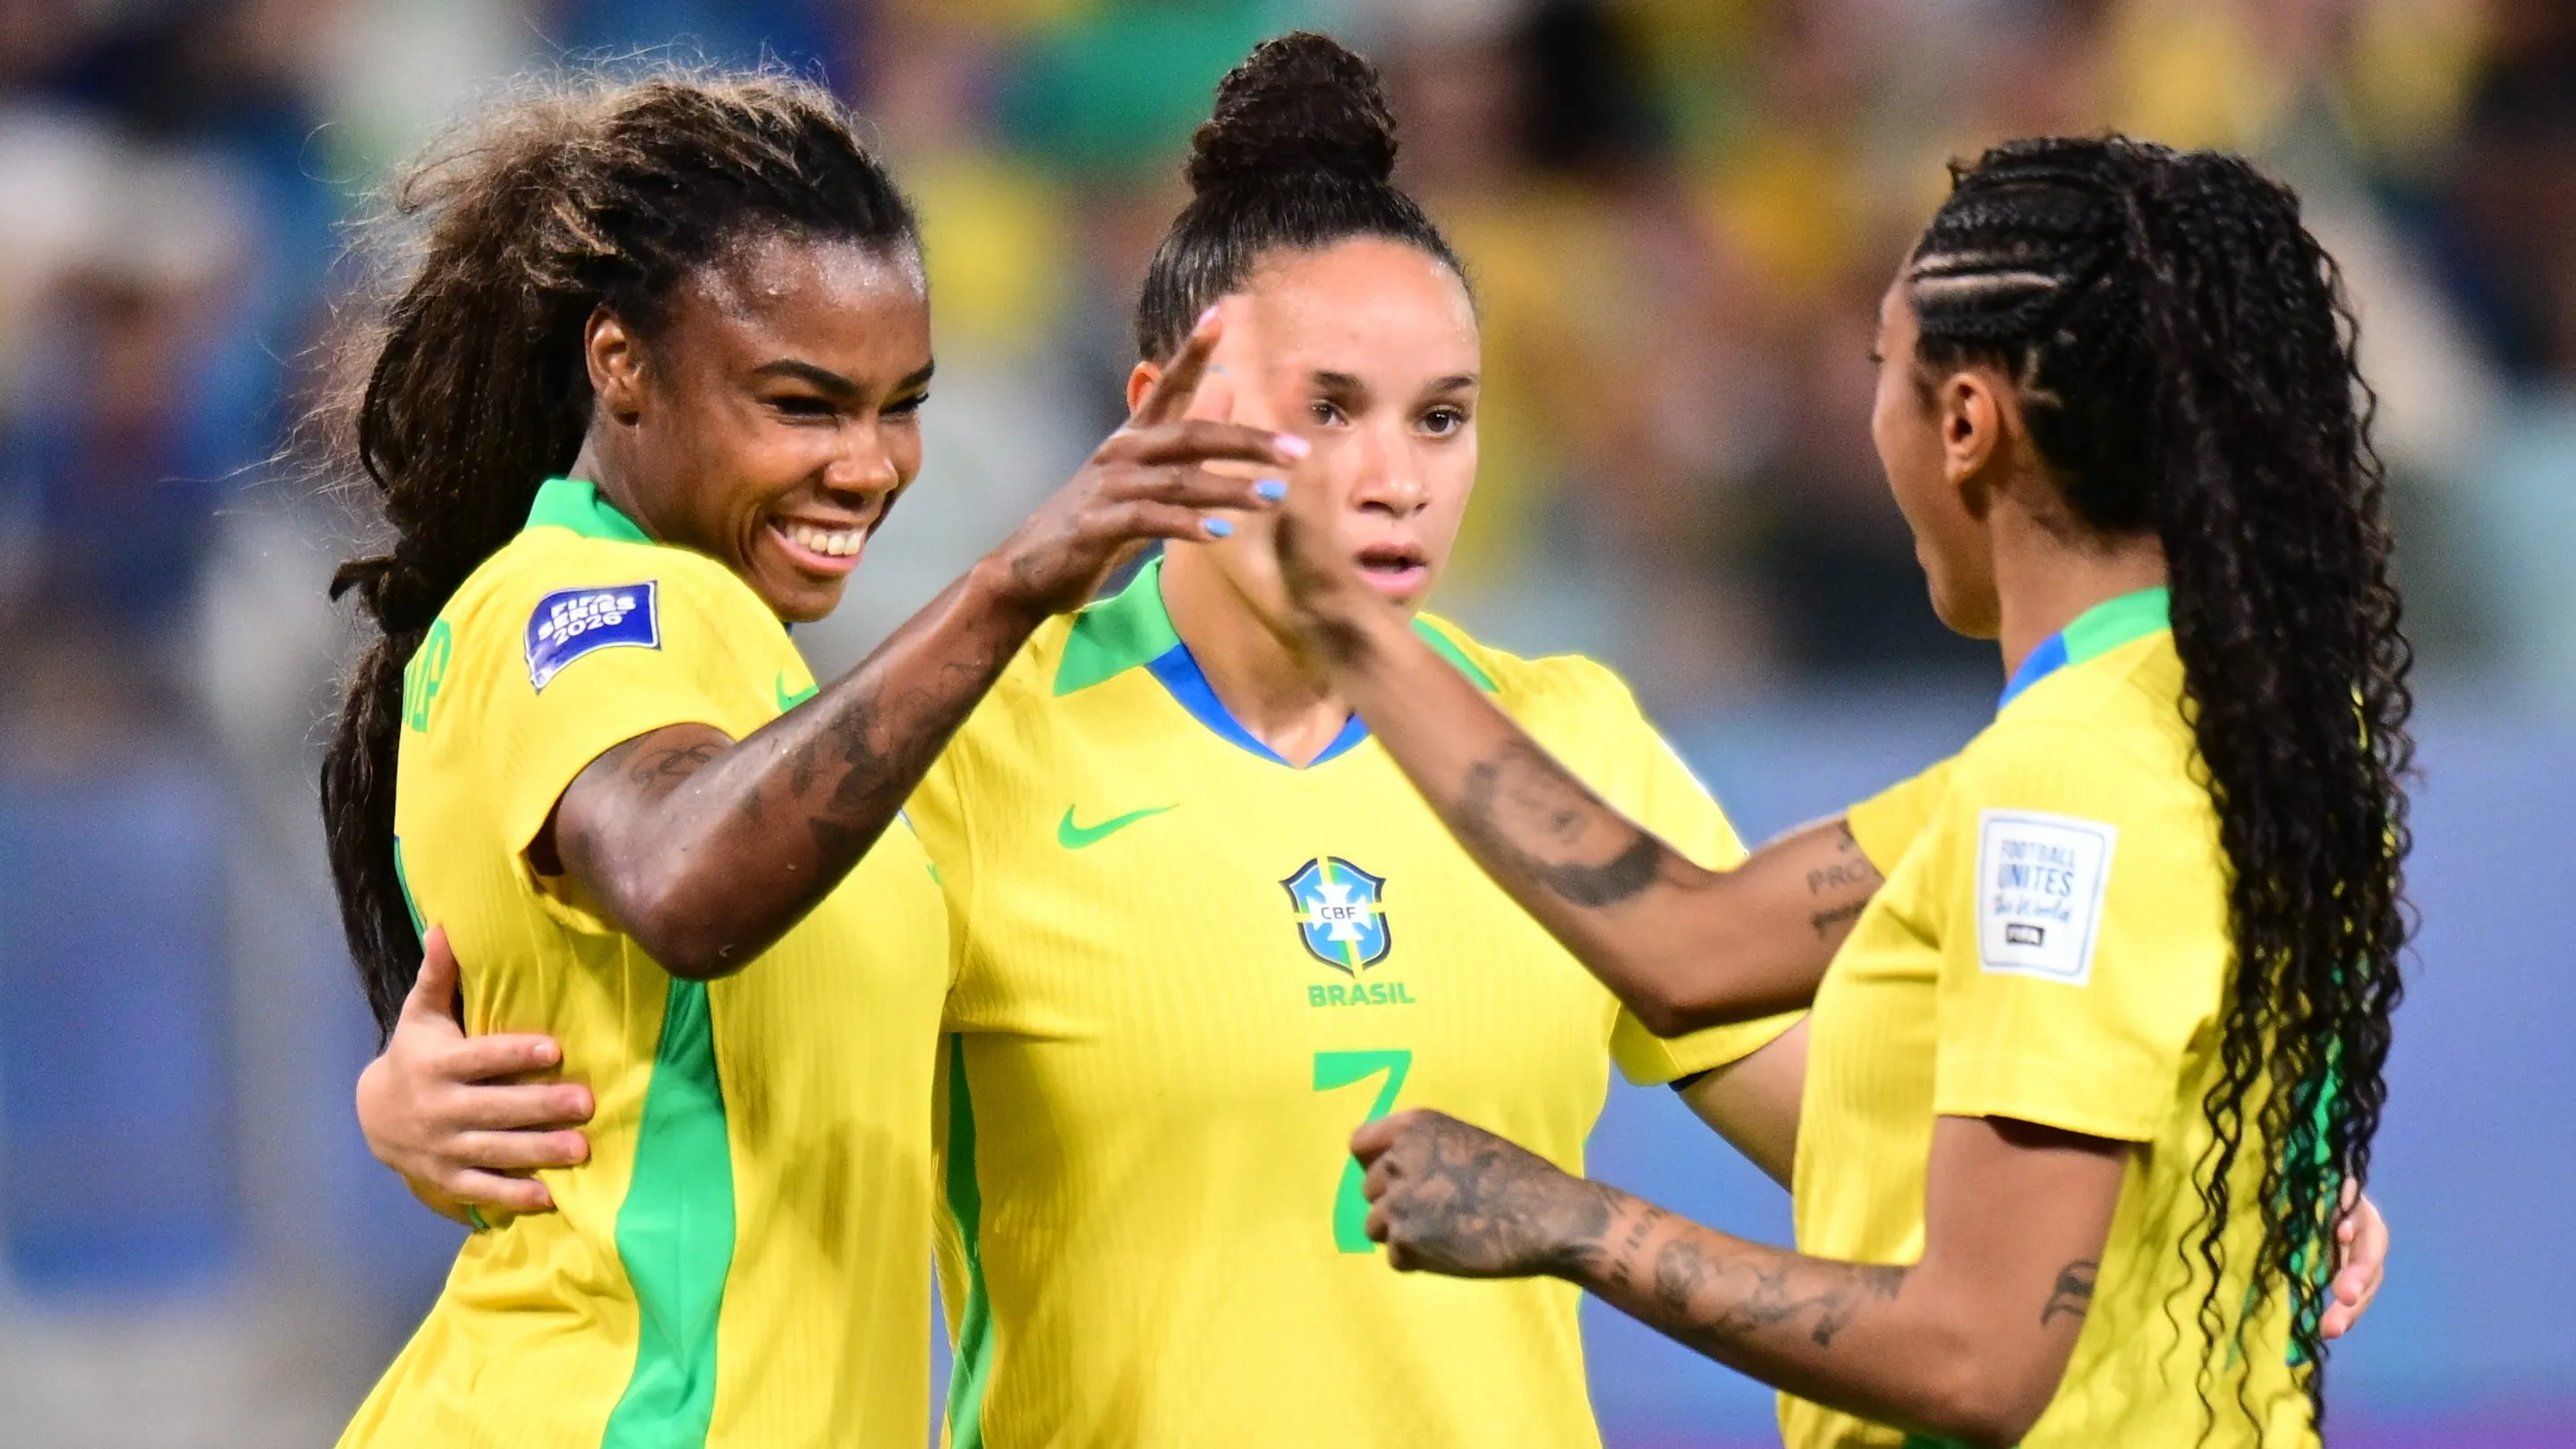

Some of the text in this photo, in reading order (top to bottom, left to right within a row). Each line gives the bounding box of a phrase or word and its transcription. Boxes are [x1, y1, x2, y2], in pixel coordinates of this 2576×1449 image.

[539, 597, 635, 640] SERIES
[551, 594, 616, 618] FIFA
[552, 609, 626, 646] 2026
[1997, 862, 2074, 897] UNITES
[1321, 907, 1356, 920] CBF
[1307, 982, 1416, 1008] BRASIL
[1313, 1049, 1412, 1254] 7
